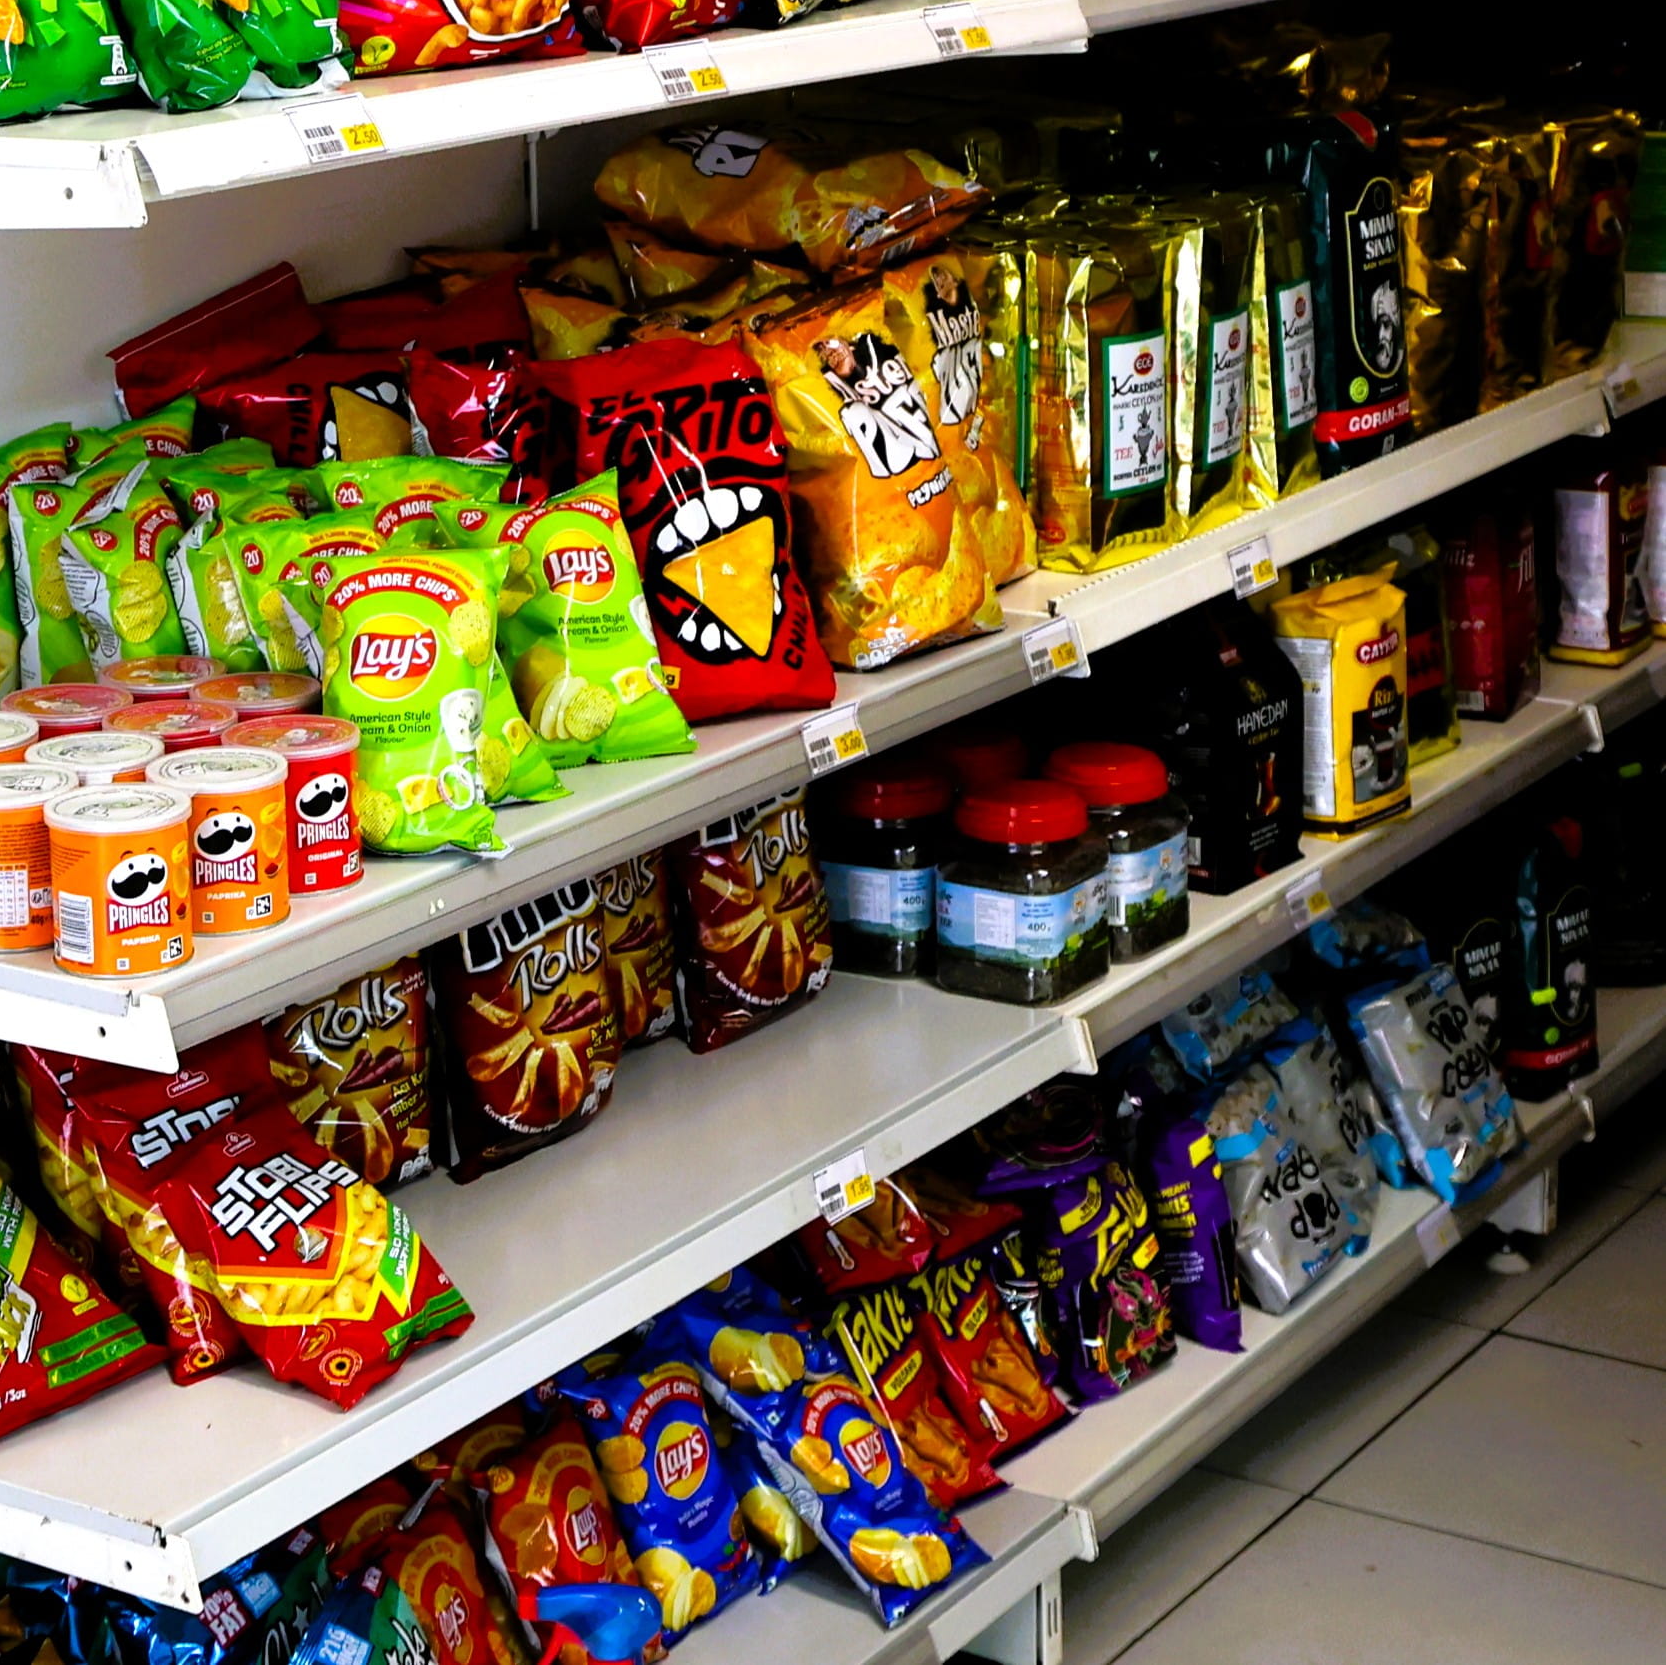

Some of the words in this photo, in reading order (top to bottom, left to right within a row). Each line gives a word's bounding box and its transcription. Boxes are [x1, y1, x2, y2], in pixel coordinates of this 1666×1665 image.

[699, 71, 723, 88] 2.50
[349, 127, 379, 147] 2.50
[926, 306, 982, 349] Maste
[1114, 446, 1134, 462] TEE
[399, 499, 434, 517] MORE
[507, 510, 535, 539] 20%
[548, 545, 611, 586] Lay's
[334, 581, 366, 606] 20%
[367, 572, 410, 589] MORE
[414, 574, 457, 603] CHIPS
[592, 625, 600, 635] &
[600, 623, 629, 634] Onion
[602, 613, 626, 626] Style
[352, 631, 433, 681] Lay's
[349, 711, 402, 725] American
[403, 709, 432, 725] Style
[396, 723, 407, 736] &
[408, 721, 433, 735] Onion
[1237, 698, 1289, 736] HANEDAN
[297, 813, 350, 849] PRINGLES
[195, 854, 257, 886] PRINGLES
[307, 849, 345, 863] ORIGINAL
[108, 895, 170, 929] PRINGLES
[121, 933, 161, 947] PAPRIKA
[508, 924, 604, 1011] Rolls
[284, 976, 407, 1071] Rolls
[212, 1153, 313, 1237] STOBI
[246, 1160, 360, 1252] FLIPS
[659, 1430, 705, 1488] Lay's
[210, 1603, 248, 1646] FAT
